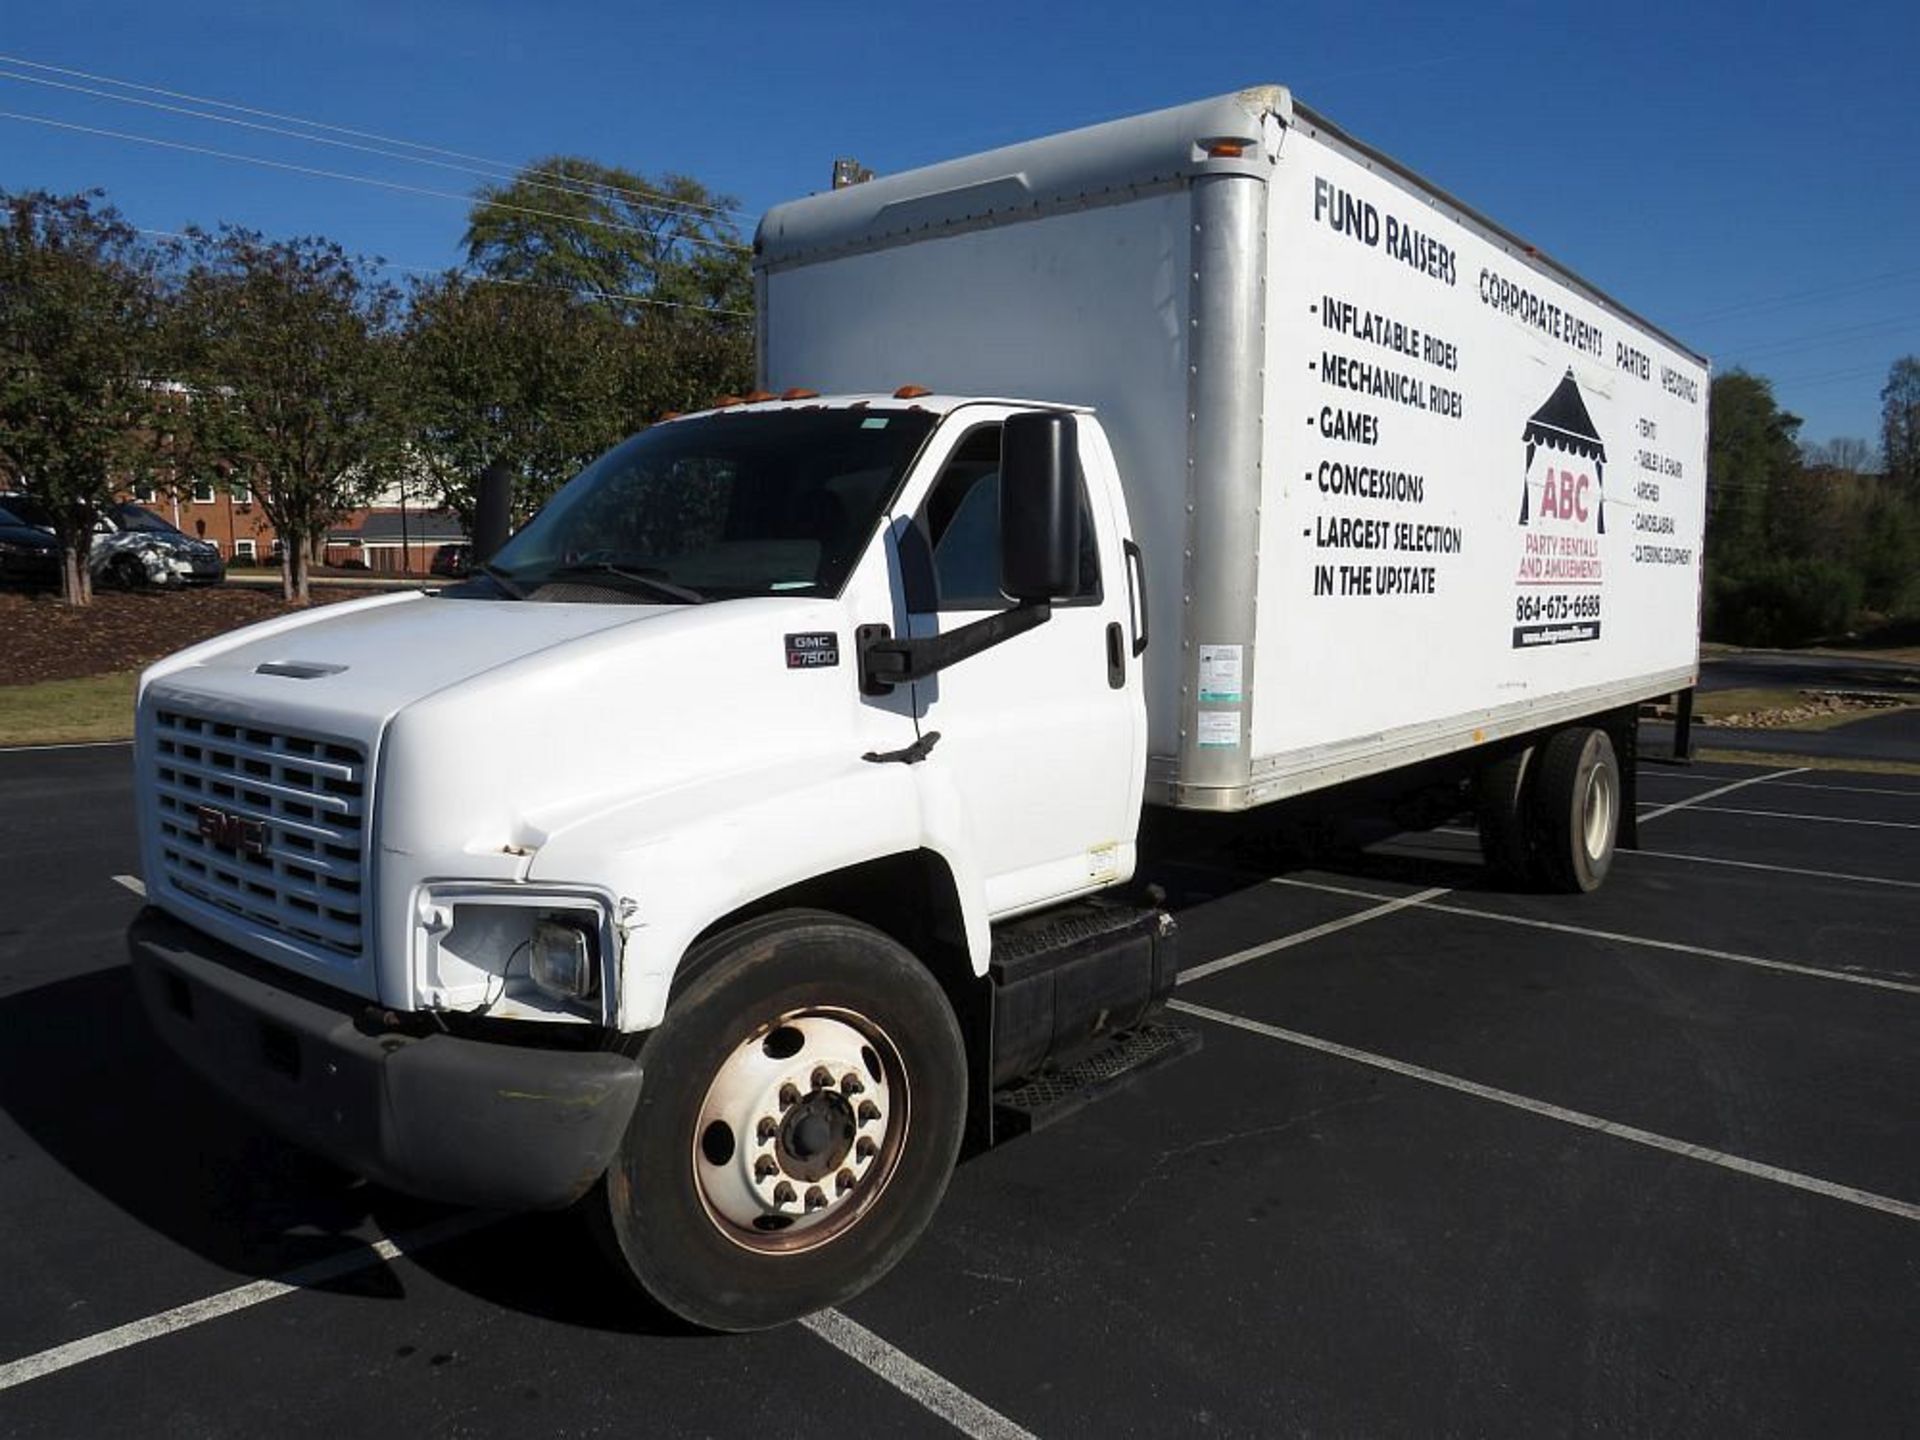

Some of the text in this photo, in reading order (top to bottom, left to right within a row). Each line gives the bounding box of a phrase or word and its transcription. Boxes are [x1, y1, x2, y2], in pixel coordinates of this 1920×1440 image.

[1314, 176, 1456, 287] FUND RAISERS
[1480, 268, 1561, 339] CORPORATE
[1322, 295, 1458, 372] INFLATABLE RIDES
[1322, 351, 1463, 419] MECHANICAL RIDES
[1320, 406, 1379, 446] GAMES
[1318, 460, 1424, 504] CONCESSIONS
[1540, 467, 1589, 523] ABC
[1316, 516, 1462, 553] LARGEST SELECTION
[1525, 533, 1598, 557] PARTY RENTALS
[1314, 565, 1436, 596] IN THE UPSTATE
[1519, 557, 1602, 579] AND AMUSEMENTS
[1516, 594, 1600, 622] 864-675-6688
[794, 636, 830, 648] GMC
[198, 806, 265, 854] GMC
